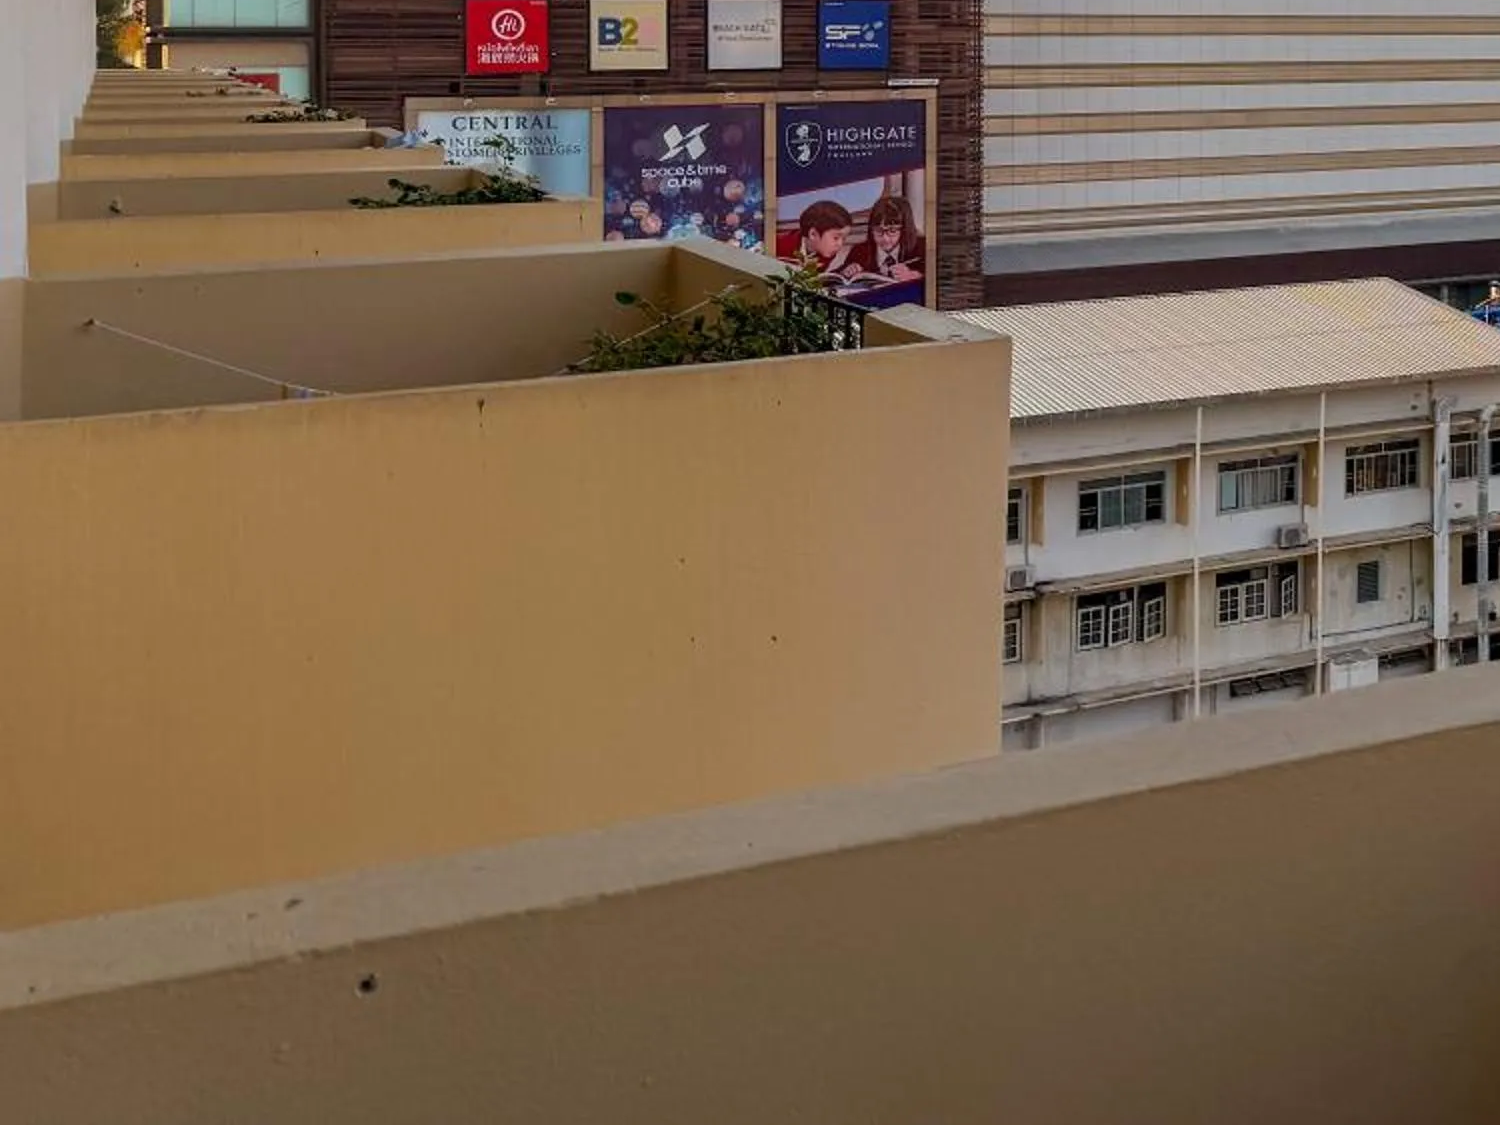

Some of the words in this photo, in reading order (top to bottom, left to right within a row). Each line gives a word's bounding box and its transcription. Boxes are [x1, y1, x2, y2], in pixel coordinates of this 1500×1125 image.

[598, 16, 658, 46] B2
[452, 116, 559, 131] CENTRAL
[450, 135, 559, 148] INTERTIONAL
[827, 126, 917, 142] HIGHGATE
